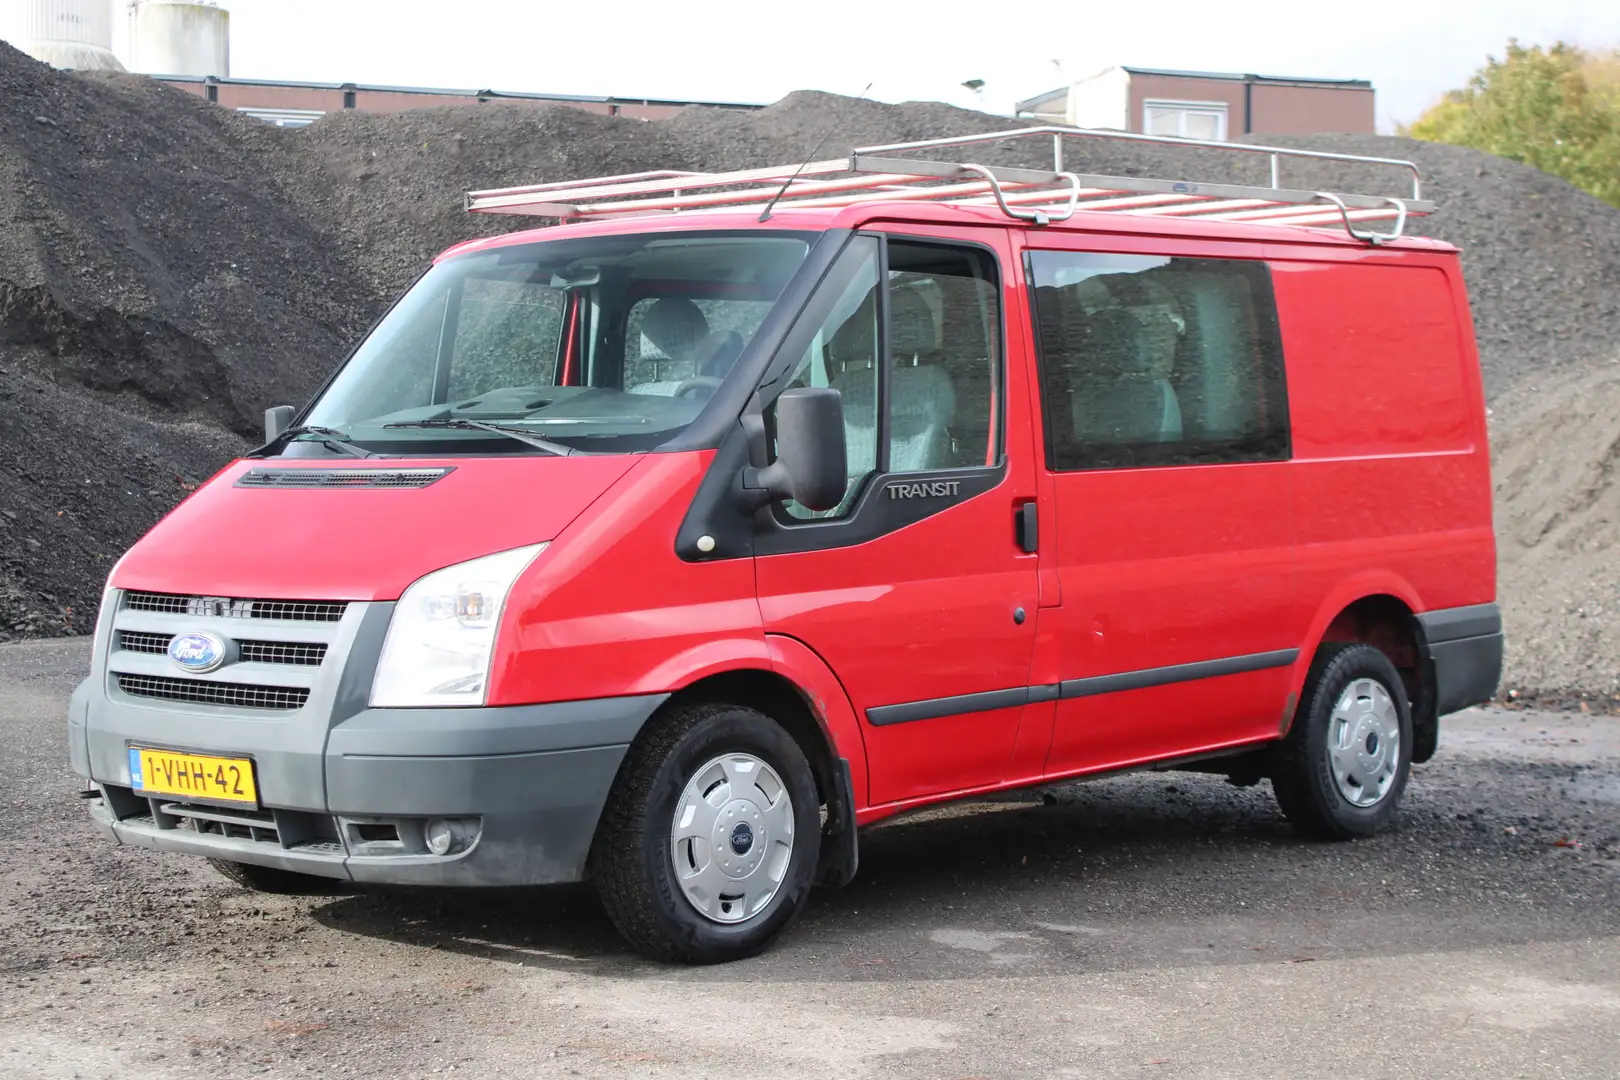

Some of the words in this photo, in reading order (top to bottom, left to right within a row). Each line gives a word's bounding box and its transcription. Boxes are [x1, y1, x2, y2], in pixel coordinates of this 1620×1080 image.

[886, 481, 961, 500] TRANSIT
[172, 638, 208, 661] Ford
[131, 773, 142, 784] NL
[147, 756, 245, 795] 1-VHH-42
